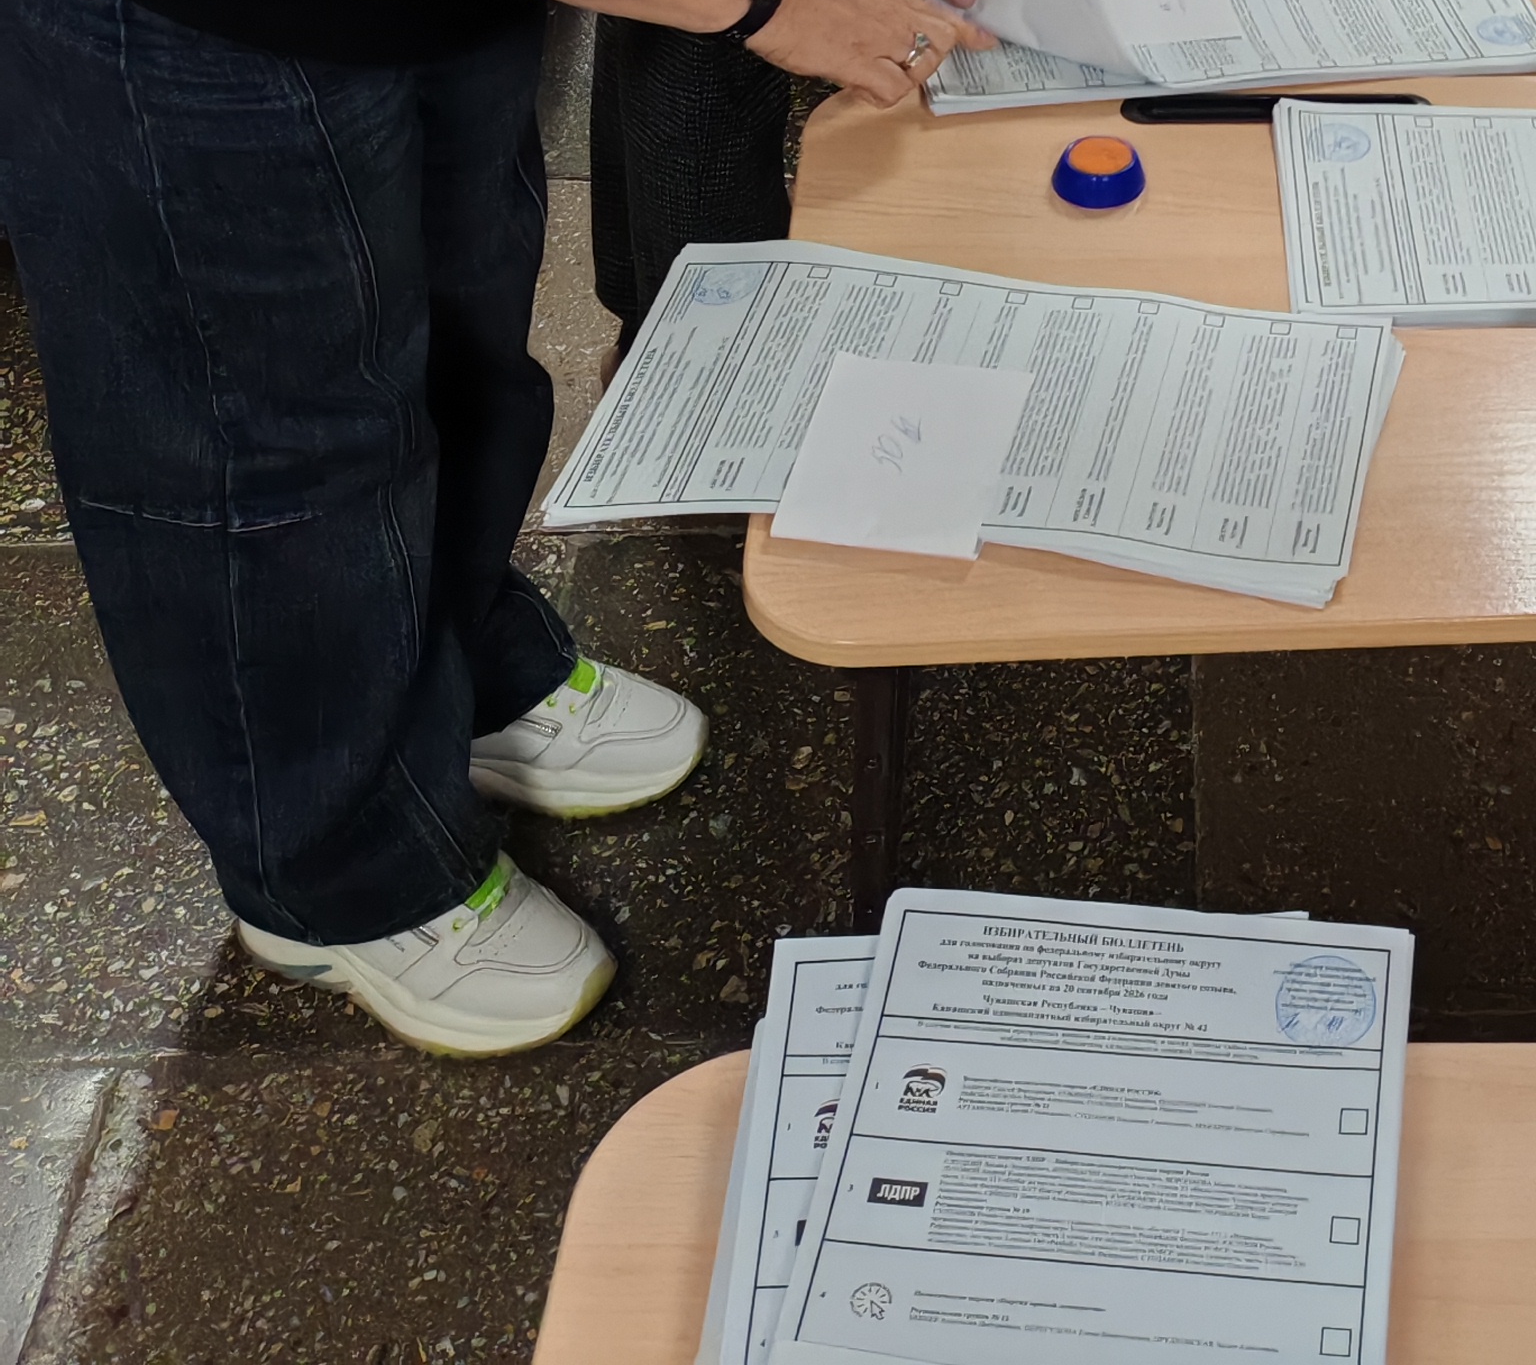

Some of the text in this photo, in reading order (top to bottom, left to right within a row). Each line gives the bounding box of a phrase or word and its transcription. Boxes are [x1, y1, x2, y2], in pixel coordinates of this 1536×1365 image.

[983, 925, 1184, 953] ИЗБИРАТЕЛЬНЫЙ БЮЛЛЕТЕНЬ
[898, 1097, 938, 1107] ЕДИНАЯ
[897, 1105, 936, 1114] РОССИЯ
[876, 1182, 921, 1201] ЛДПР
